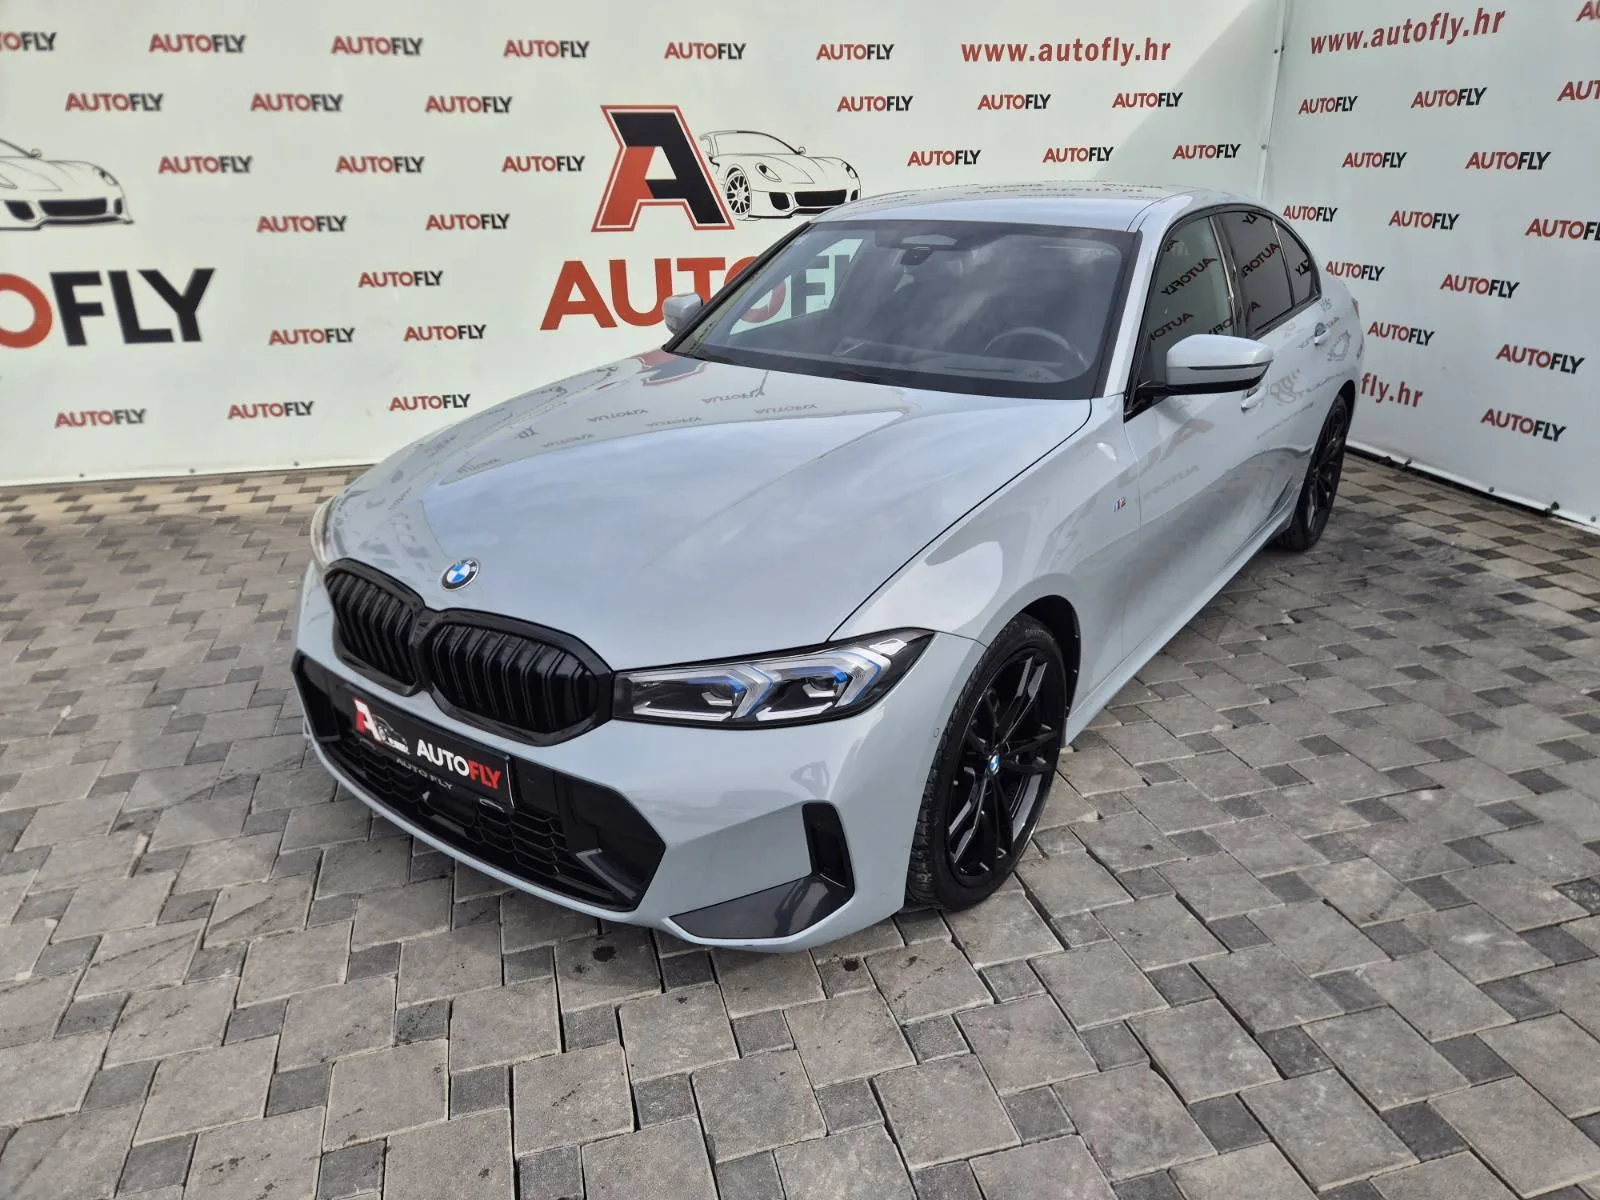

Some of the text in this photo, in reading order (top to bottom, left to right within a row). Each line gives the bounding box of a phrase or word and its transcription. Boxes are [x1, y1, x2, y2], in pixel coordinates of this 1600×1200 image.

[1311, 8, 1505, 54] www.autofly.hr
[0, 32, 56, 51] OFLY
[150, 35, 245, 53] AUTOFLY
[332, 37, 423, 55] AUTOFLY
[504, 40, 589, 58] AUTOFLY
[664, 42, 746, 60] AUTOFLY
[816, 44, 894, 60] AUTOFLY
[961, 37, 1171, 66] www.autofly.hr
[66, 93, 163, 111] AUTOFLY
[251, 94, 342, 111] AUTOFLY
[426, 96, 512, 113] AUTOFLY
[837, 96, 913, 112] AUTOFLY
[978, 94, 1051, 110] AUTOFLY
[1112, 92, 1183, 108] AUTOFLY
[1299, 96, 1358, 114] AUTOFLY
[1411, 87, 1487, 108] AUTOFLY
[907, 150, 981, 166] AUTOFLY
[1043, 147, 1114, 163] AUTOFLY
[1172, 144, 1241, 159] AUTOFLY
[1342, 152, 1407, 168] AUTOFLY
[159, 156, 252, 173] AUTOFLY
[336, 157, 424, 173] AUTOFLY
[502, 156, 585, 172] AUTOFLY
[1465, 152, 1551, 170] AUTOFLY
[426, 214, 510, 230] AUTOFLY
[1283, 205, 1338, 222] AUTOFLY
[1388, 211, 1460, 230] AUTOFLY
[258, 216, 346, 232] AUTOFLY
[359, 271, 443, 288] AUTOFLY
[1326, 261, 1385, 281] AUTOFLY
[1440, 274, 1520, 299] AUTOFLY
[0, 268, 216, 349] OFLY
[269, 328, 355, 345] AUTOFLY
[404, 324, 486, 341] AUTOFLY
[1368, 321, 1435, 346] AUTOFLY
[1496, 344, 1584, 374] AUTOFLY
[1361, 373, 1423, 407] fly.hr
[228, 401, 314, 419] AUTOFLY
[389, 394, 471, 411] AUTOFLY
[56, 409, 147, 427] AUTOFLY
[1480, 409, 1566, 442] AUTOFLY
[396, 757, 429, 779] AUTO
[416, 738, 502, 790] AUTOFLY
